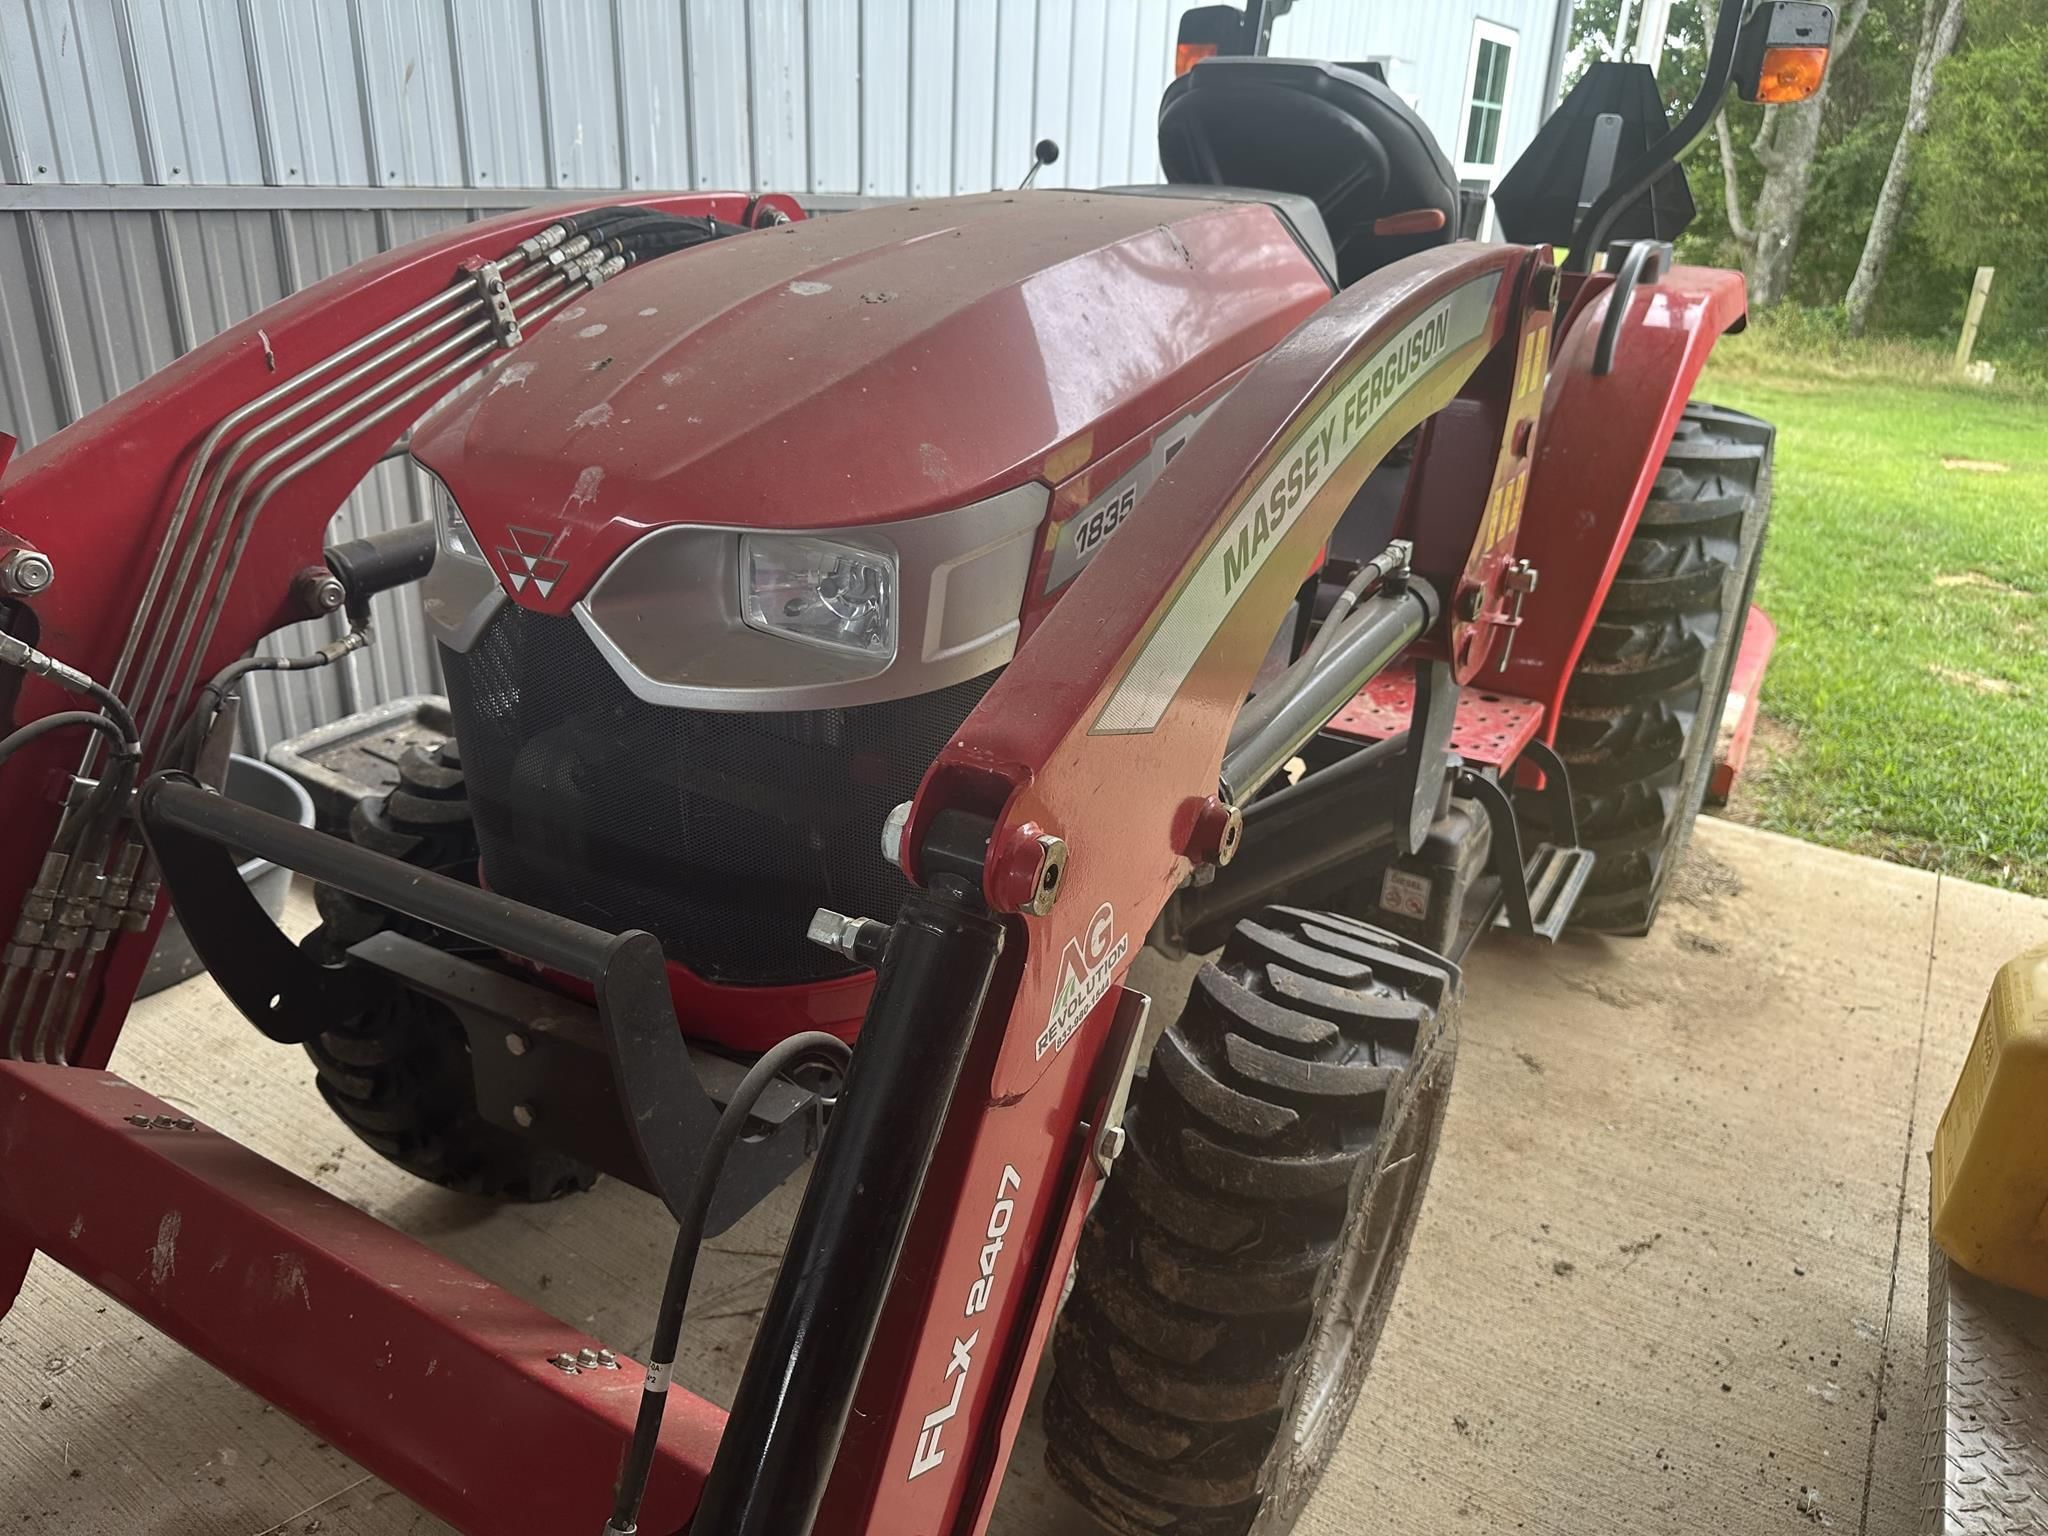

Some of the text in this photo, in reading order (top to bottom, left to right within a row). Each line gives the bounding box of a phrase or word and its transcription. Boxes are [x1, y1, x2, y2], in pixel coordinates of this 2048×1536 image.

[1223, 308, 1450, 596] MASSEY FERGUSON
[1076, 487, 1135, 555] 1835
[1037, 936, 1128, 1056] REVOLUTION
[1053, 902, 1114, 1014] AG
[908, 1163, 1022, 1482] FLX 2407
